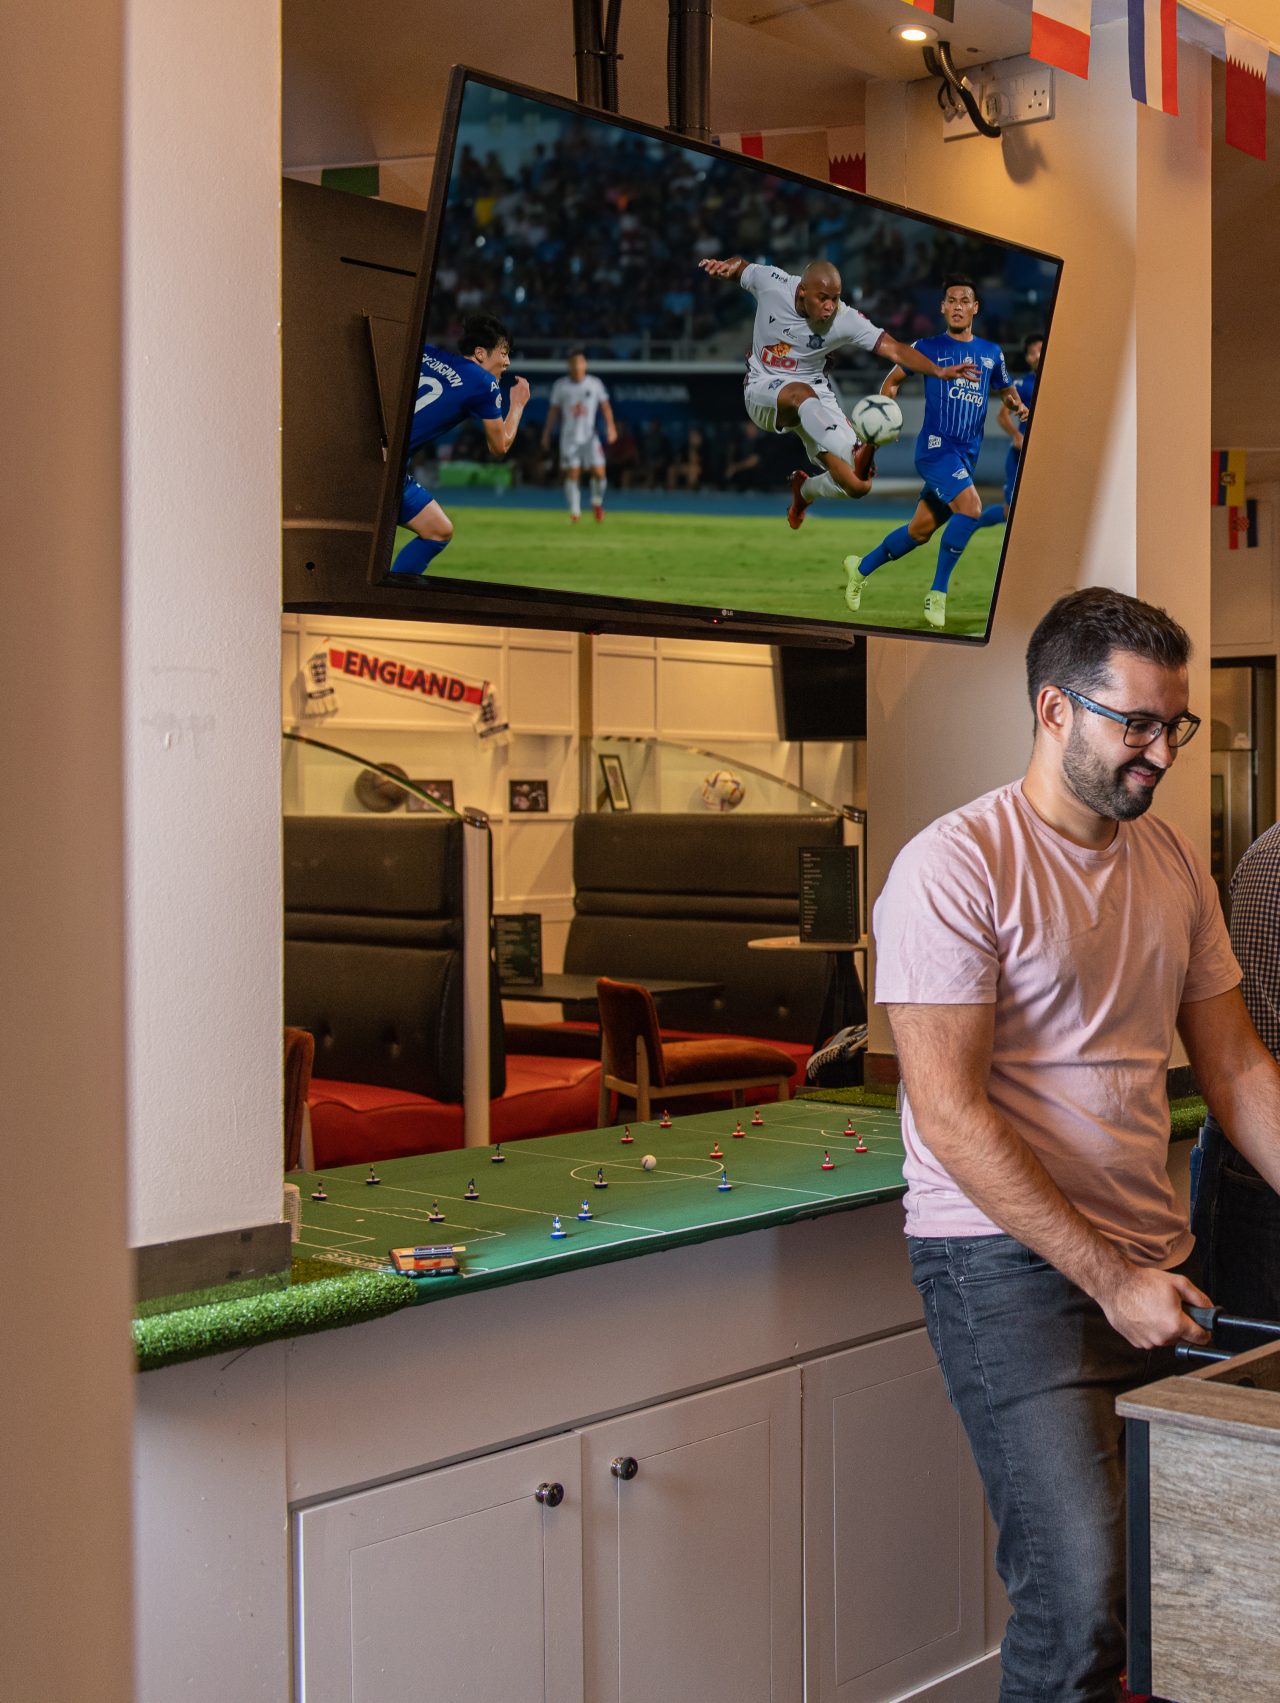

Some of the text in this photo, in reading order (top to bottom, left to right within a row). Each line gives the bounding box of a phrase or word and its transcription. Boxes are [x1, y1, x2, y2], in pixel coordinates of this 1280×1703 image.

[761, 348, 798, 369] LEO
[948, 386, 984, 407] Chang
[343, 650, 466, 702] ENGLAND
